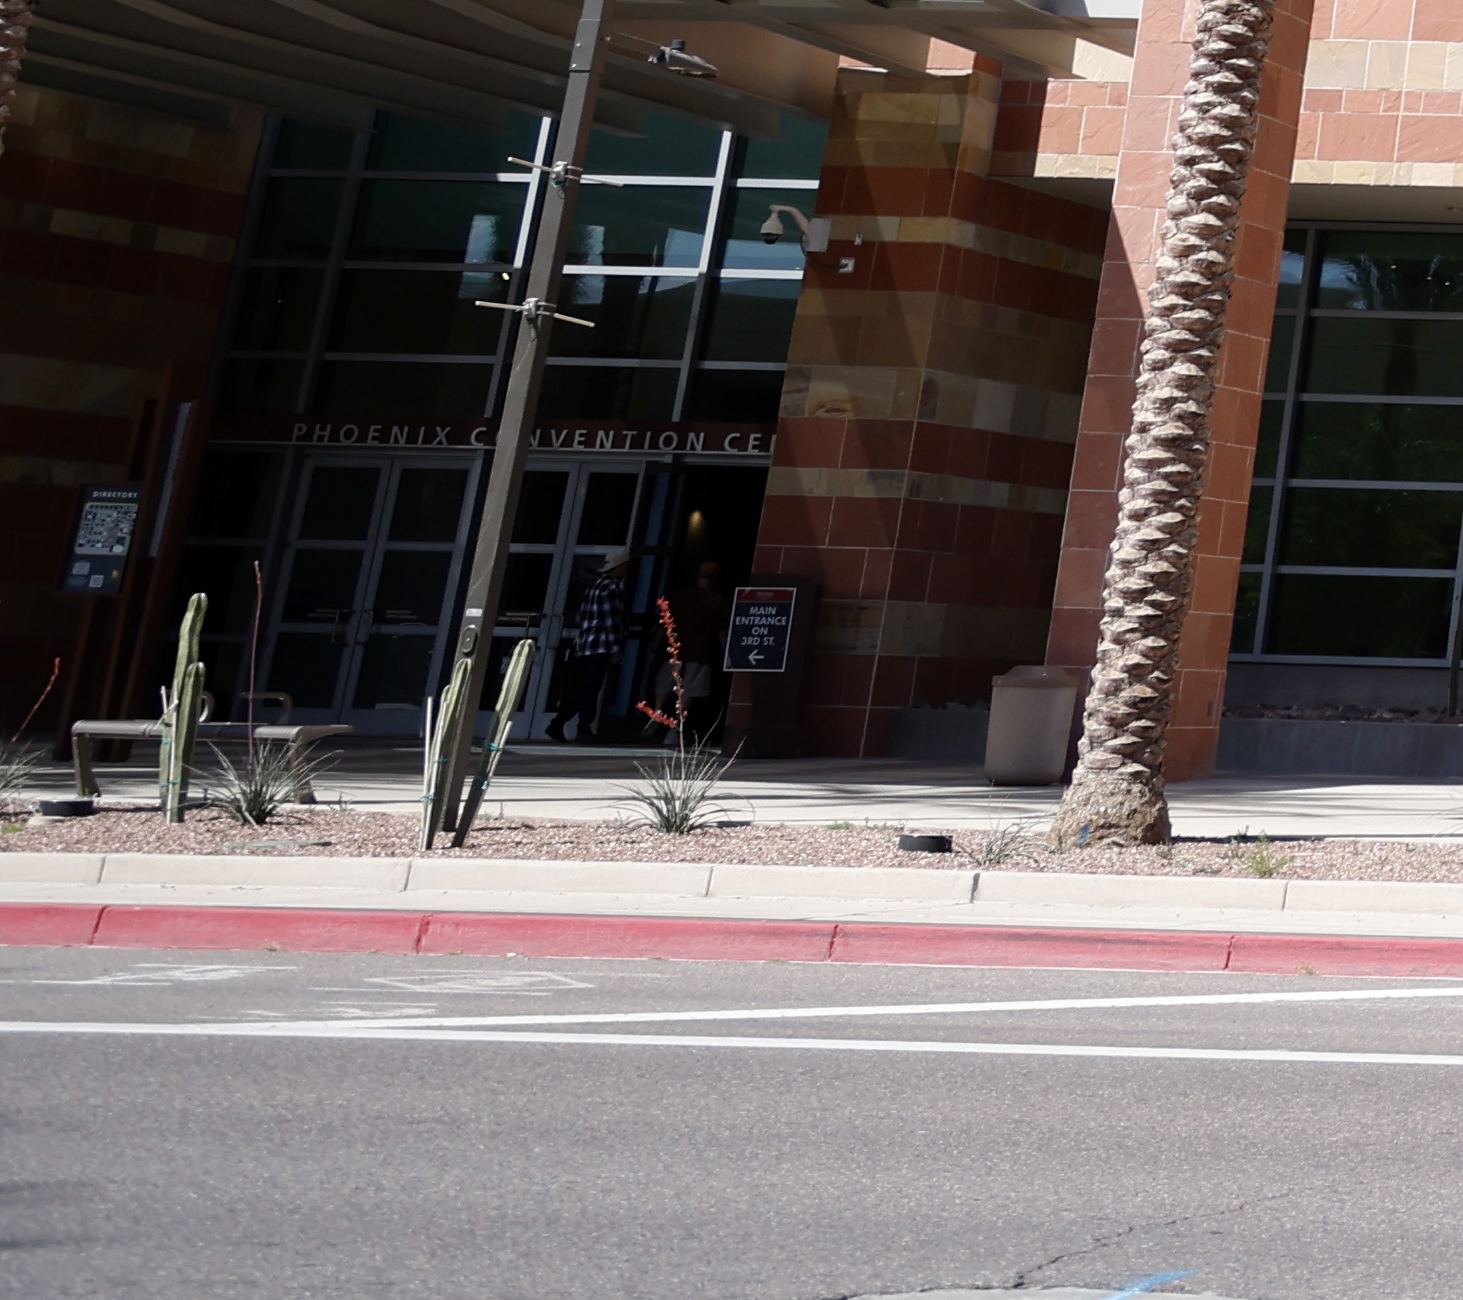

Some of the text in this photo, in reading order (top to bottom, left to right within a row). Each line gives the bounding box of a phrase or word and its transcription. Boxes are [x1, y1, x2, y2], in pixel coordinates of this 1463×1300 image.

[291, 422, 453, 447] PHOENIX
[469, 426, 706, 452] CNVENTION
[92, 490, 138, 498] DIRECTORY
[749, 606, 777, 615] MAIN
[735, 616, 787, 626] ENTRANCE
[751, 626, 769, 635] ON
[741, 636, 776, 646] 3RD ST.
